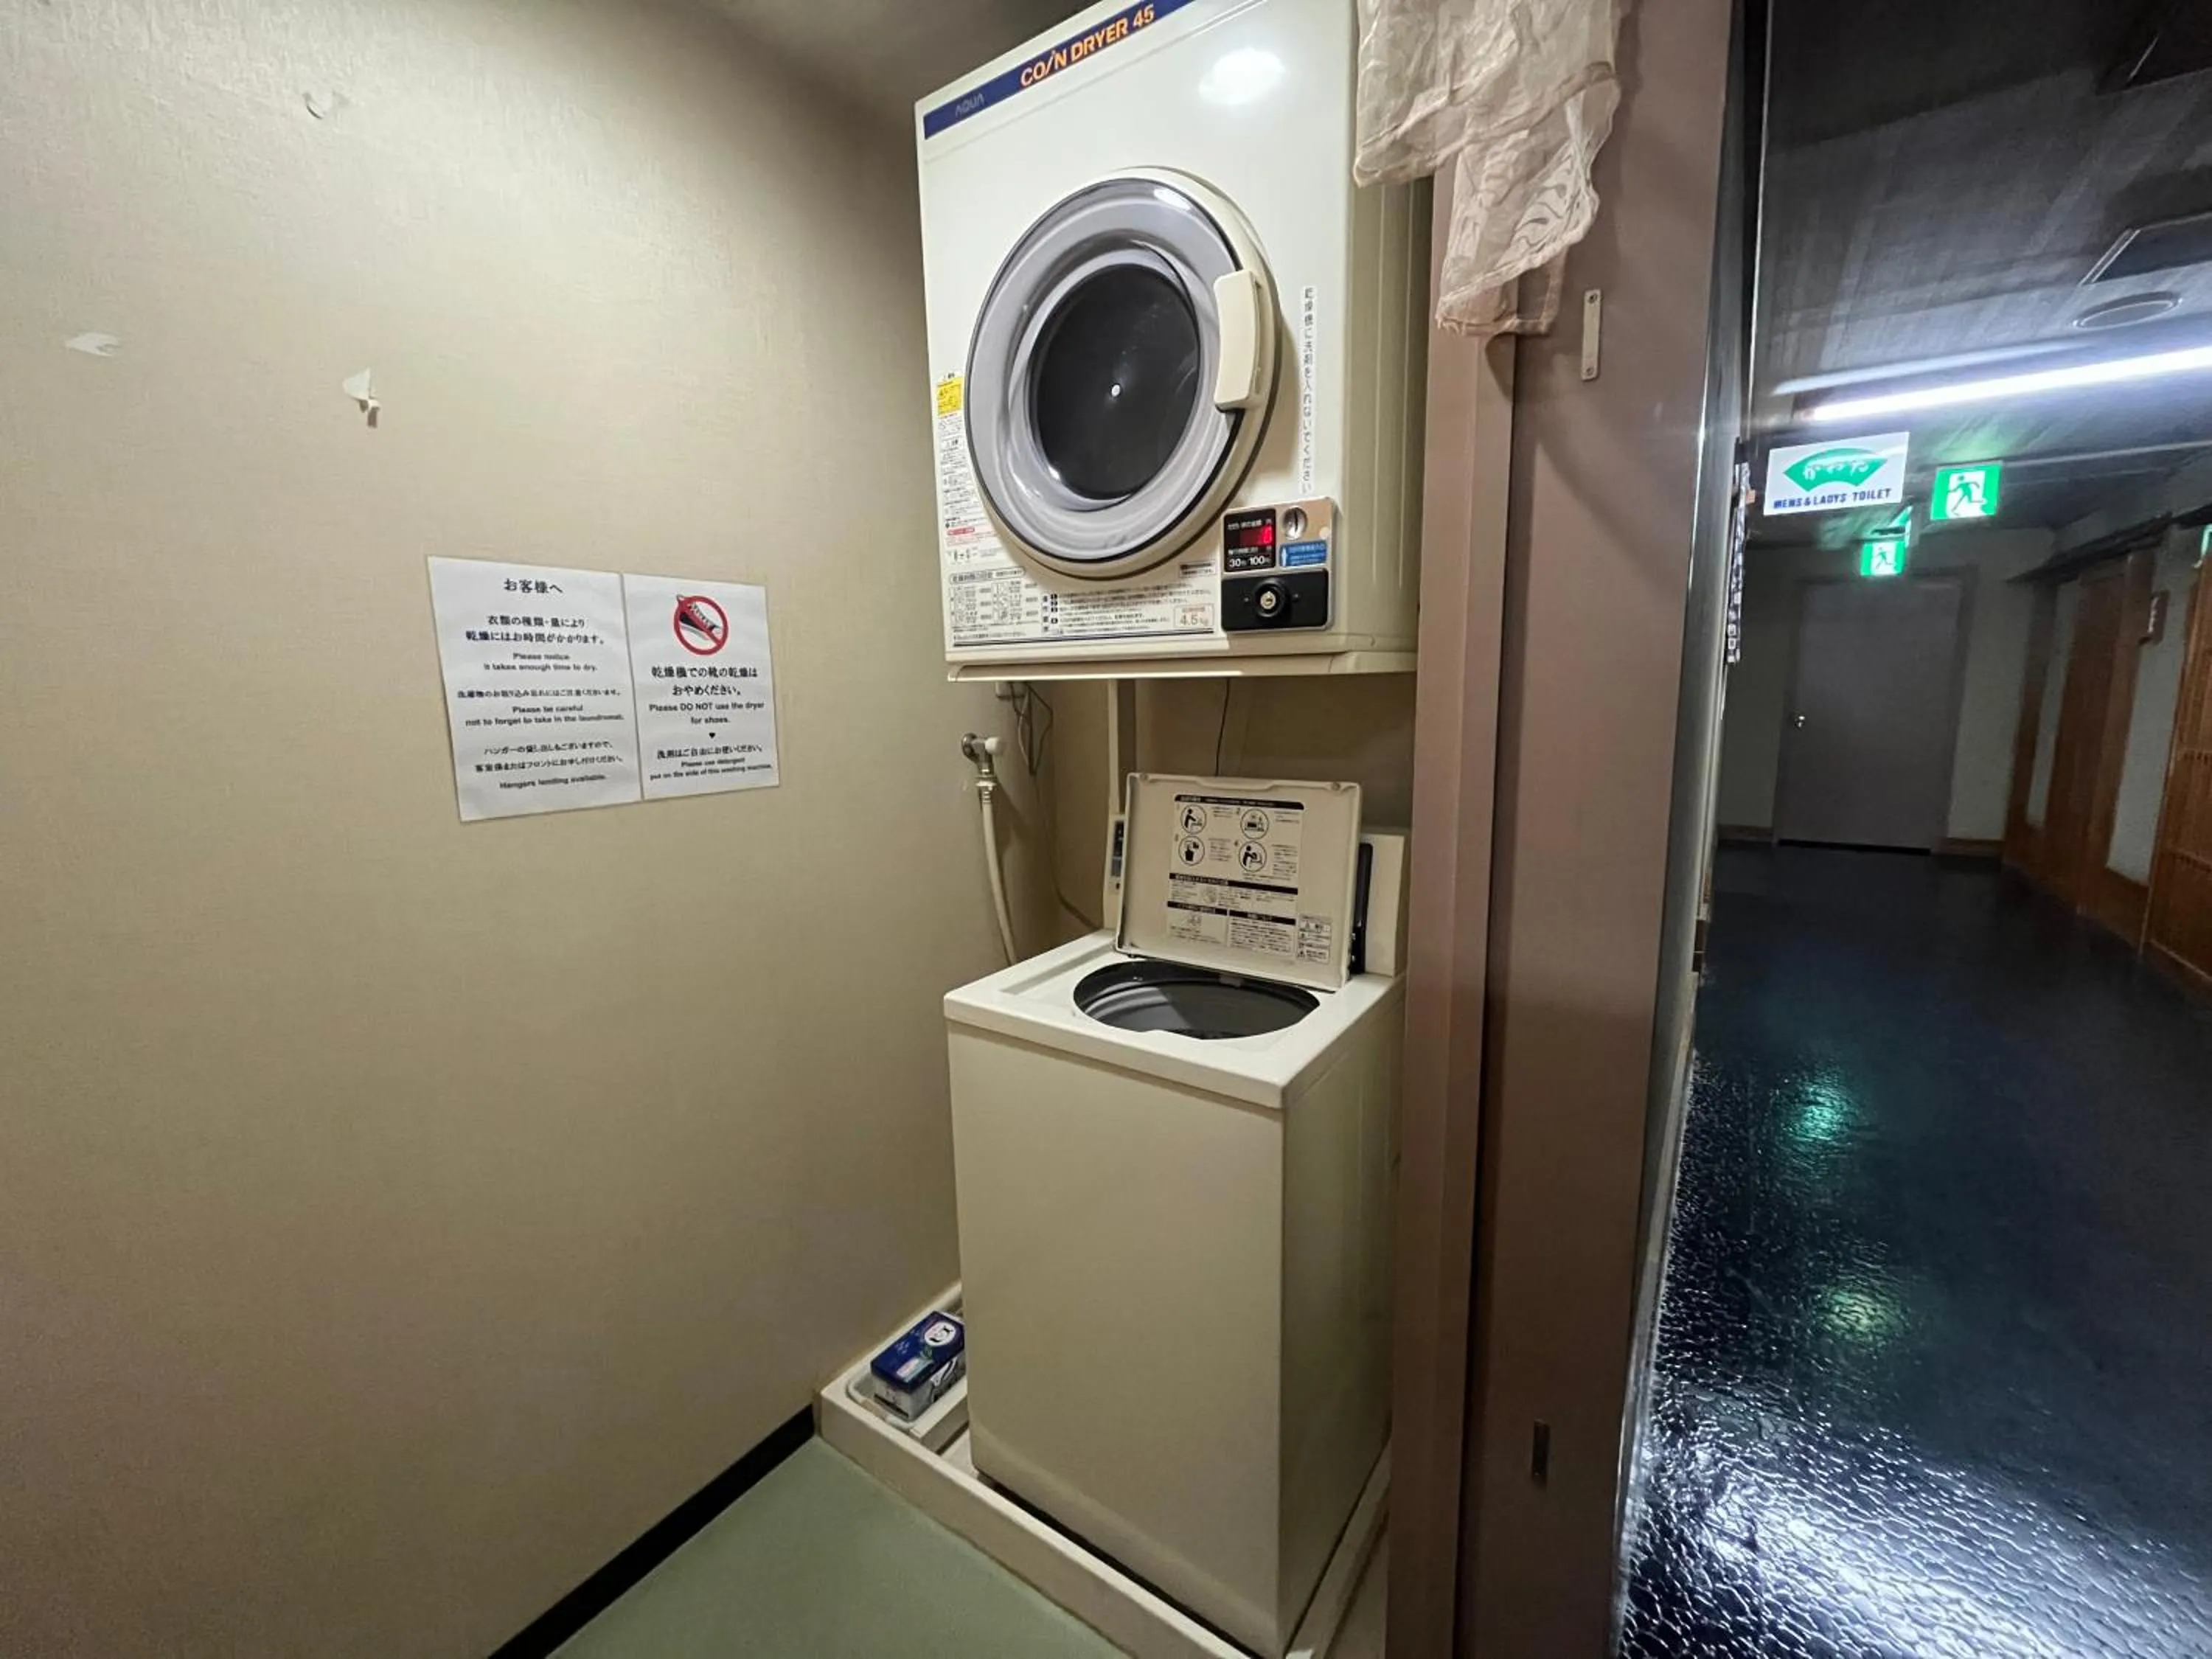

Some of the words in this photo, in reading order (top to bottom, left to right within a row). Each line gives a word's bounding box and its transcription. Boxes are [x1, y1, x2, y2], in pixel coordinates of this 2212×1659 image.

[1020, 47, 1068, 87] COIN
[1071, 17, 1128, 62] DRYER
[1133, 4, 1155, 27] 45
[1852, 487, 1892, 503] TOILET
[504, 577, 563, 594] お客様へ
[465, 630, 605, 645] 乾燥にはお時間がかかります。
[519, 664, 552, 672] enough
[651, 666, 758, 678] 乾燥機での靴の乾燥は
[672, 684, 741, 696] おやめください。
[649, 703, 678, 712] Please
[680, 703, 694, 711] DO
[695, 703, 713, 711] NOT
[745, 702, 765, 711] dryer
[465, 718, 481, 726] not
[495, 717, 521, 726] forget
[499, 780, 536, 790] Hangers
